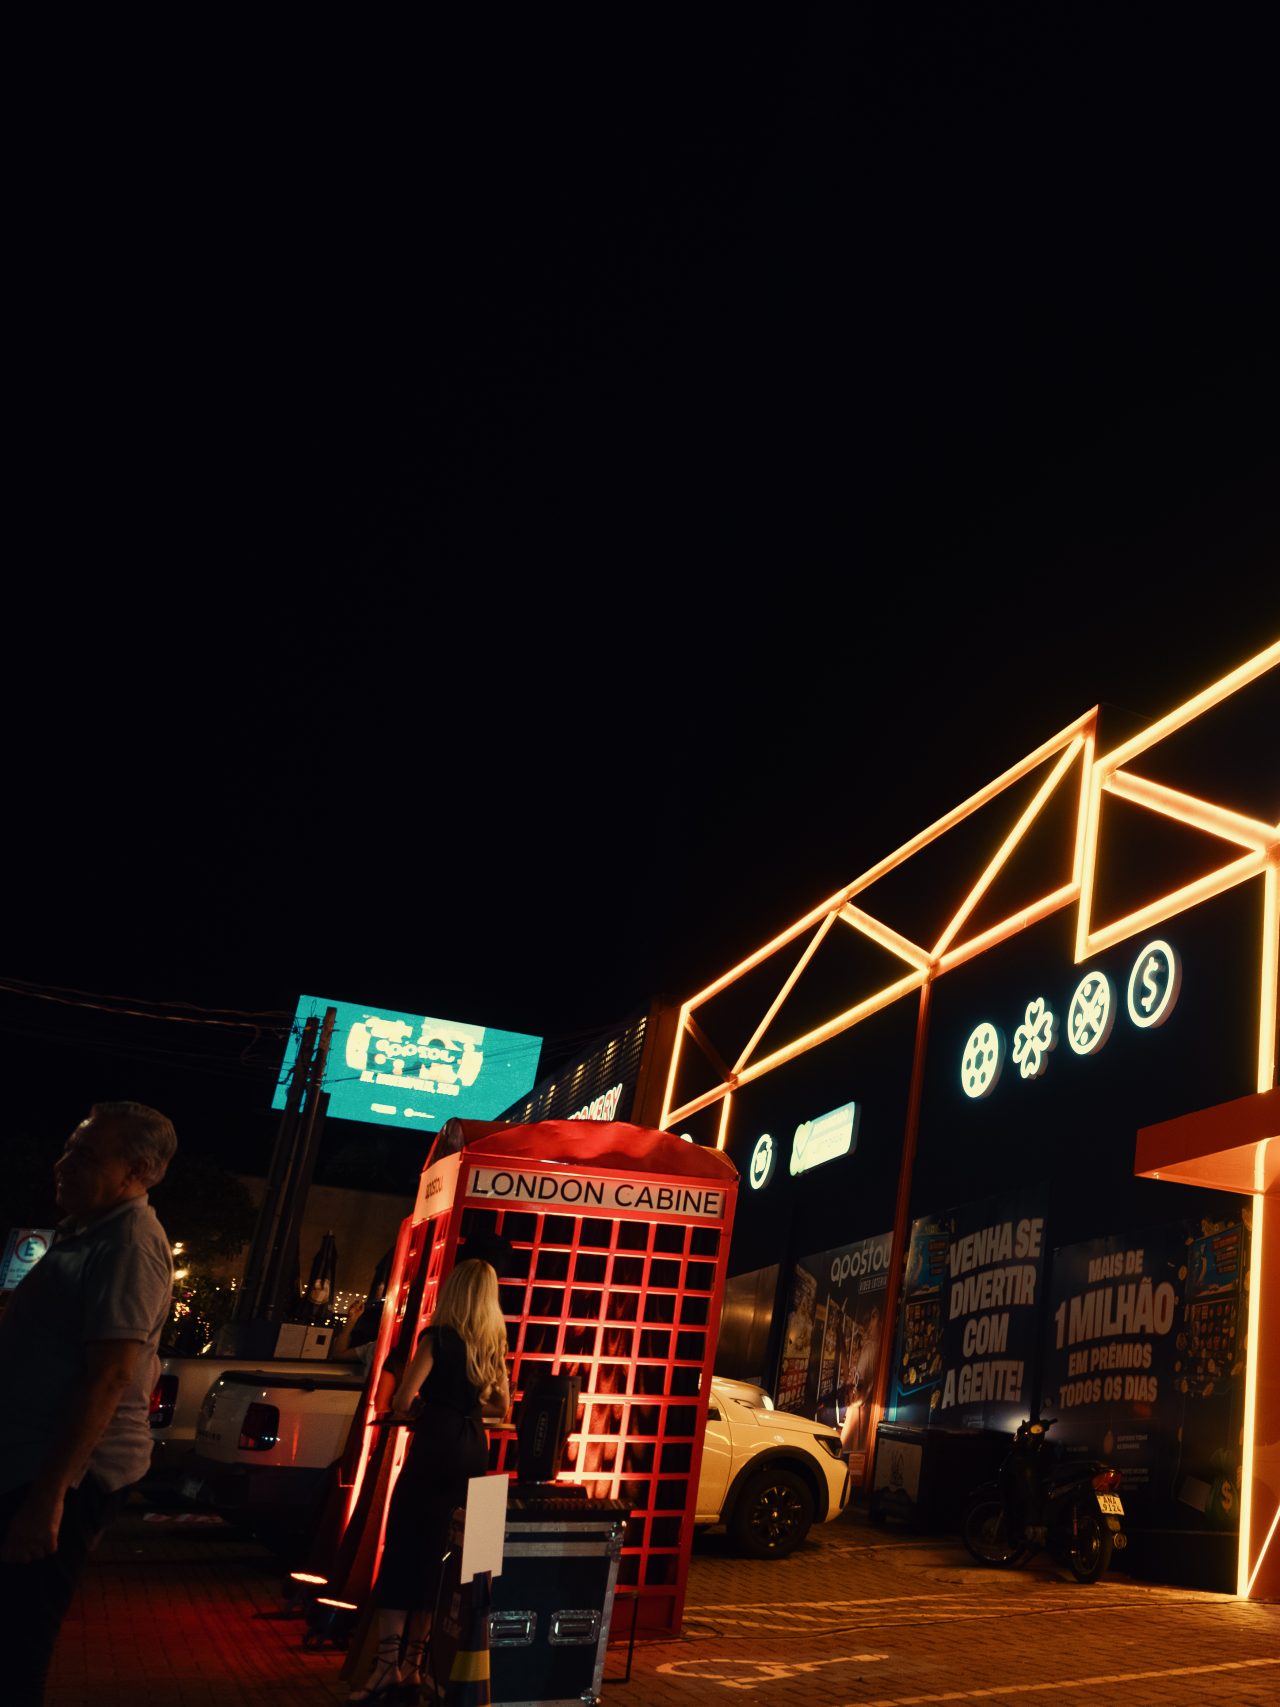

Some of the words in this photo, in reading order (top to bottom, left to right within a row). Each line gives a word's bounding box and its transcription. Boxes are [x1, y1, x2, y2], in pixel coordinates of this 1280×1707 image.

[472, 1169, 604, 1205] LONDON
[614, 1184, 720, 1215] CABINE
[24, 1241, 38, 1256] E
[949, 1221, 1014, 1279] VENHA
[1014, 1217, 1044, 1259] SE
[1088, 1252, 1124, 1284] MAIS
[1125, 1248, 1145, 1276] DE
[949, 1264, 1037, 1320] DIVERTIR
[1055, 1300, 1067, 1350] 1
[1068, 1276, 1176, 1345] MILHÃO
[962, 1312, 1010, 1358] COM
[941, 1368, 956, 1409] A
[957, 1360, 1025, 1405] GENTE!
[1068, 1349, 1089, 1377] EM
[1059, 1377, 1102, 1409] TODOS
[1103, 1375, 1123, 1401] OS
[1124, 1375, 1159, 1403] DIAS
